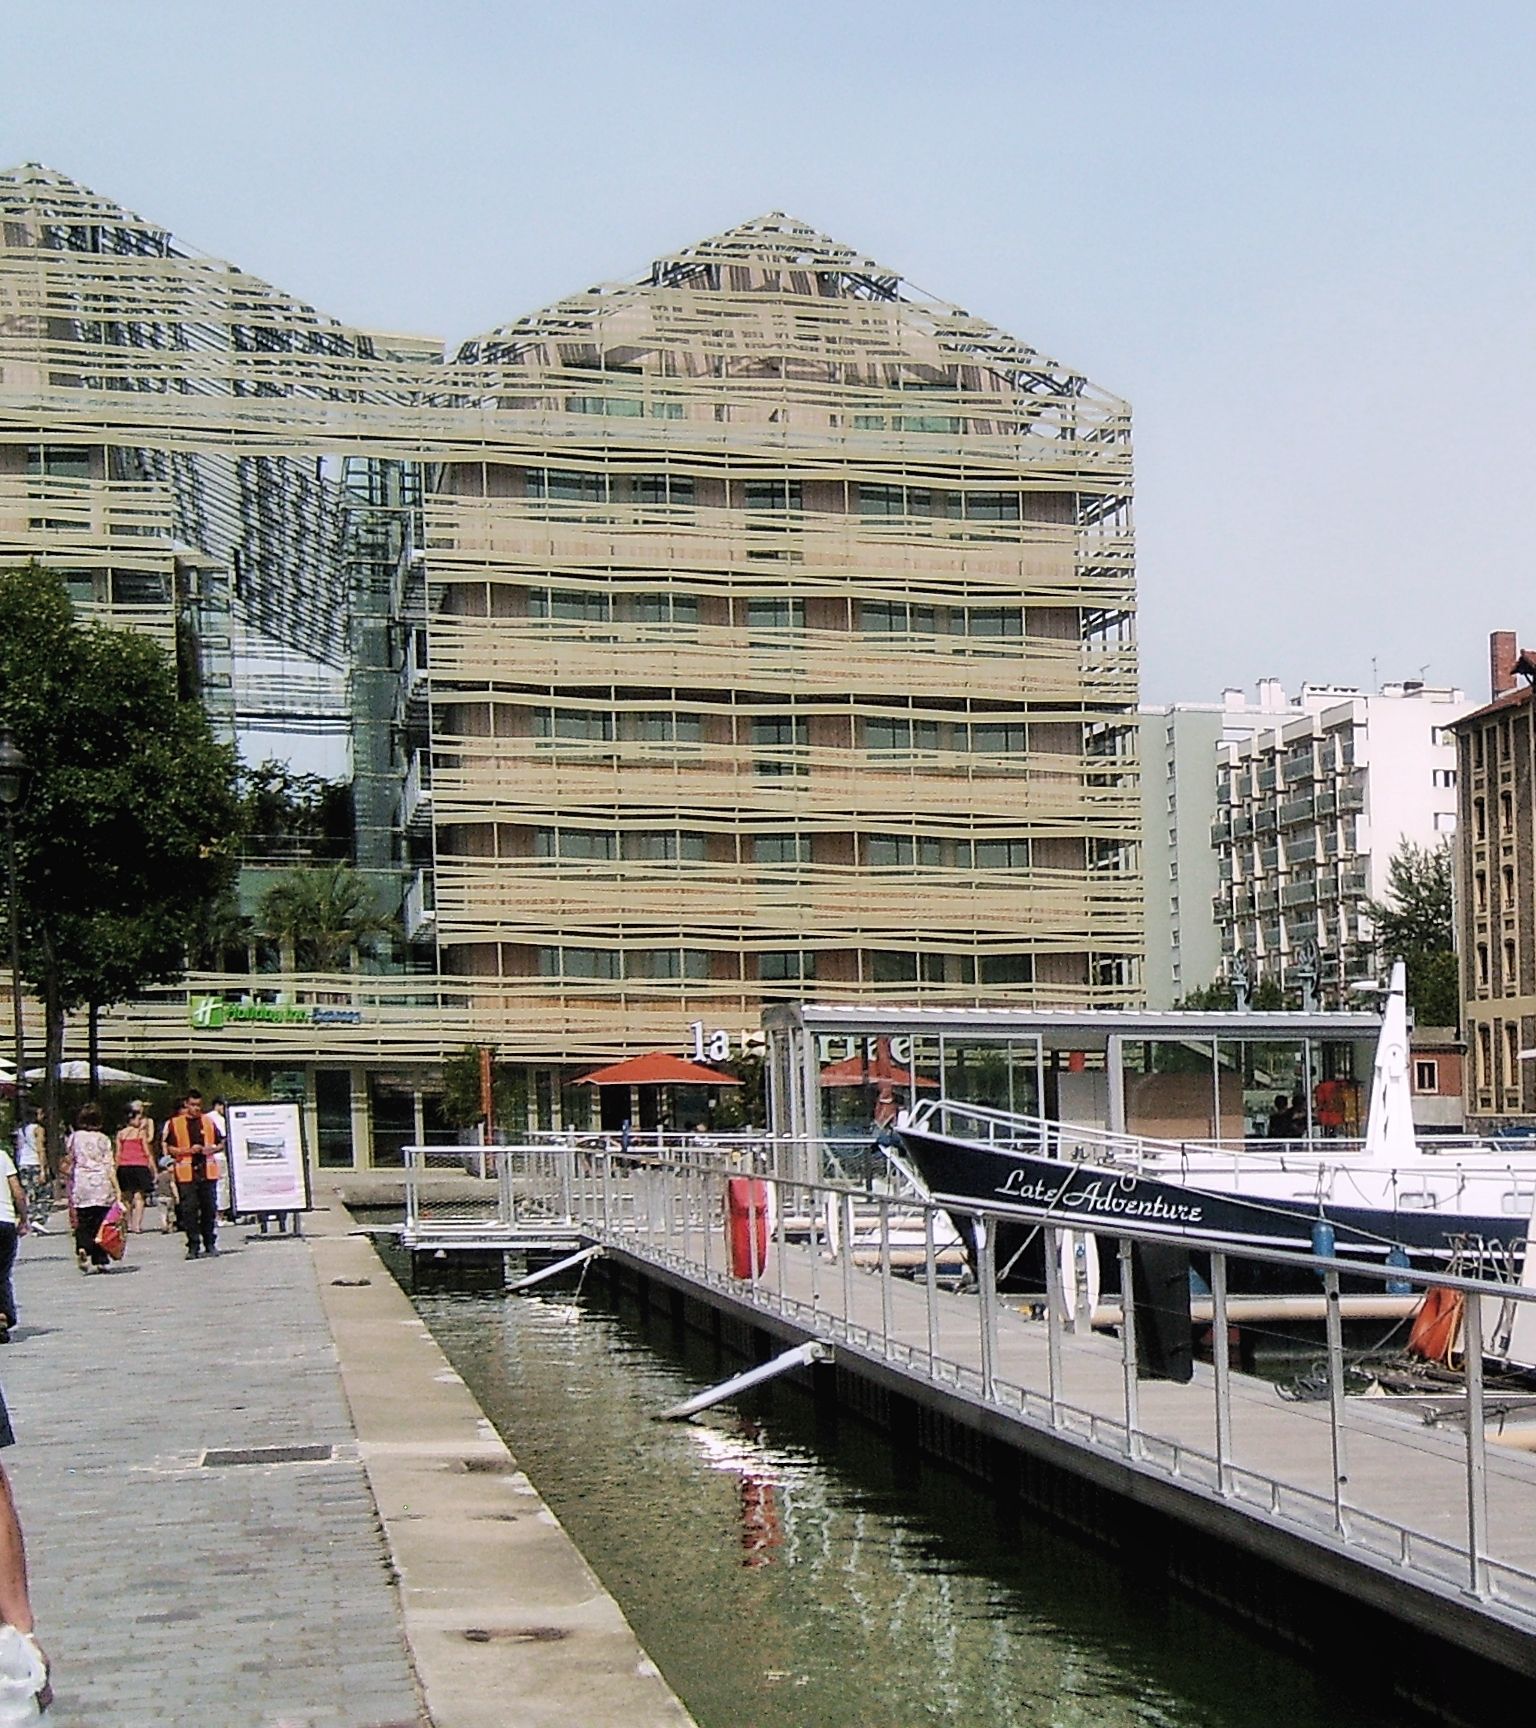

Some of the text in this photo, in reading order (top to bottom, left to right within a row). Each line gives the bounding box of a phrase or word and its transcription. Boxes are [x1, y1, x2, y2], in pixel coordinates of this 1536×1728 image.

[690, 1019, 733, 1062] la
[994, 1169, 1203, 1222] Late Adventure
